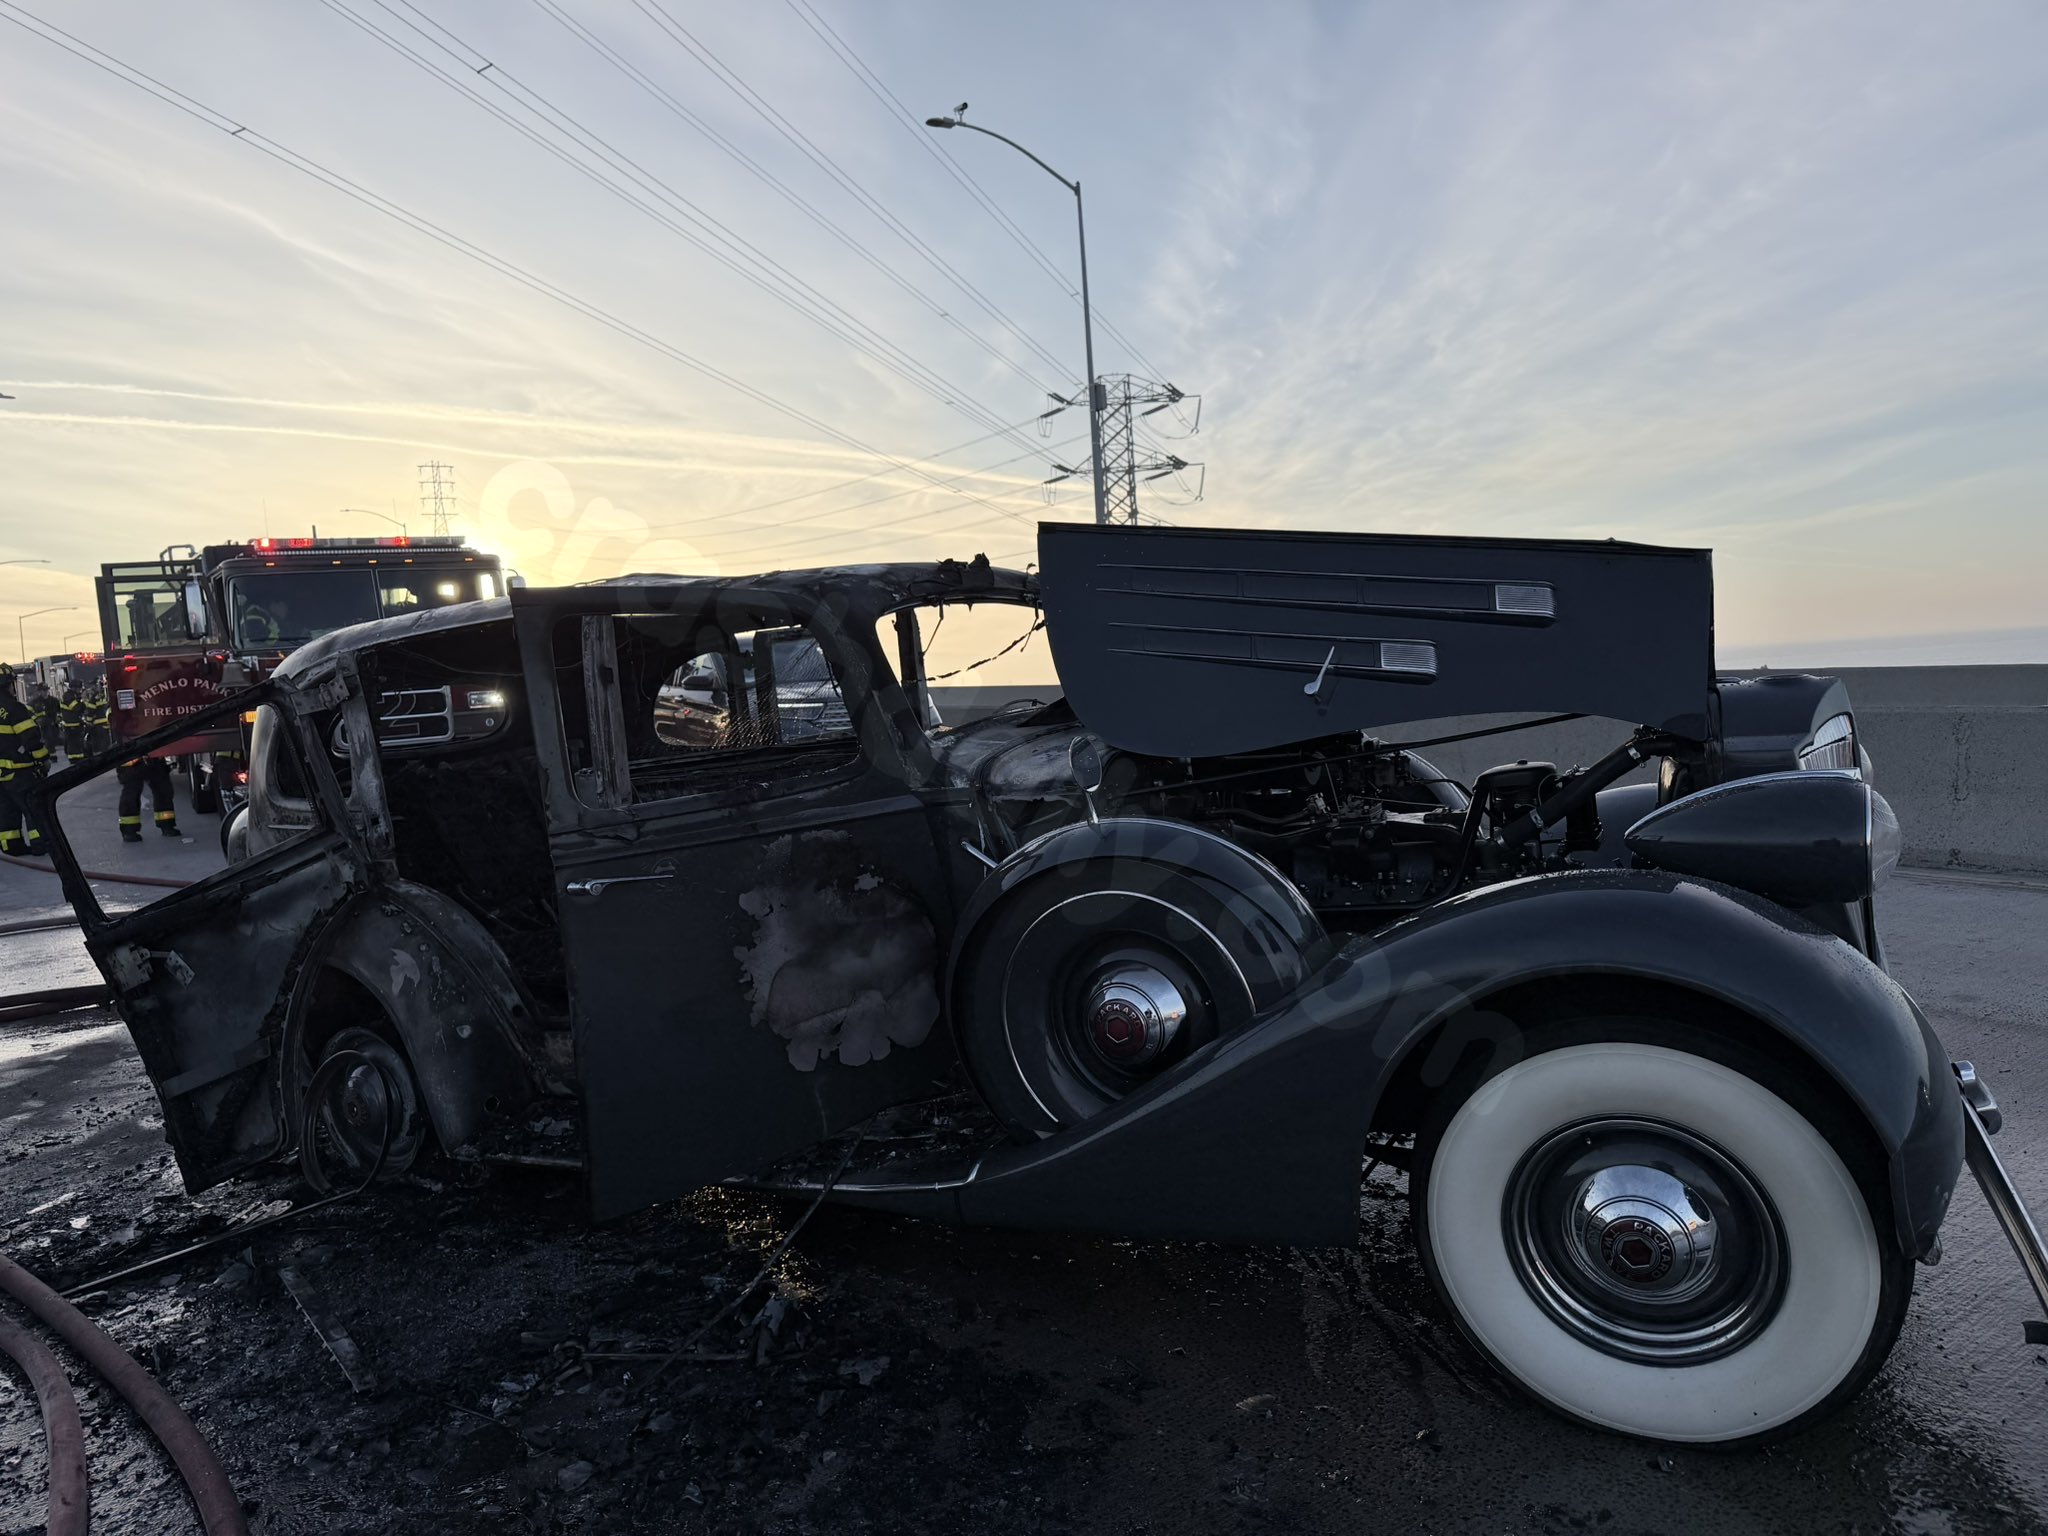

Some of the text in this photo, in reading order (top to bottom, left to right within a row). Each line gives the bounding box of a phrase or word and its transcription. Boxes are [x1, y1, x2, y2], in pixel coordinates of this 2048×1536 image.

[139, 678, 231, 702] MENLO PARK
[144, 704, 210, 717] FIRE DIST
[1096, 1003, 1141, 1027] PACKARD
[1633, 1222, 1671, 1279] PACKARD
